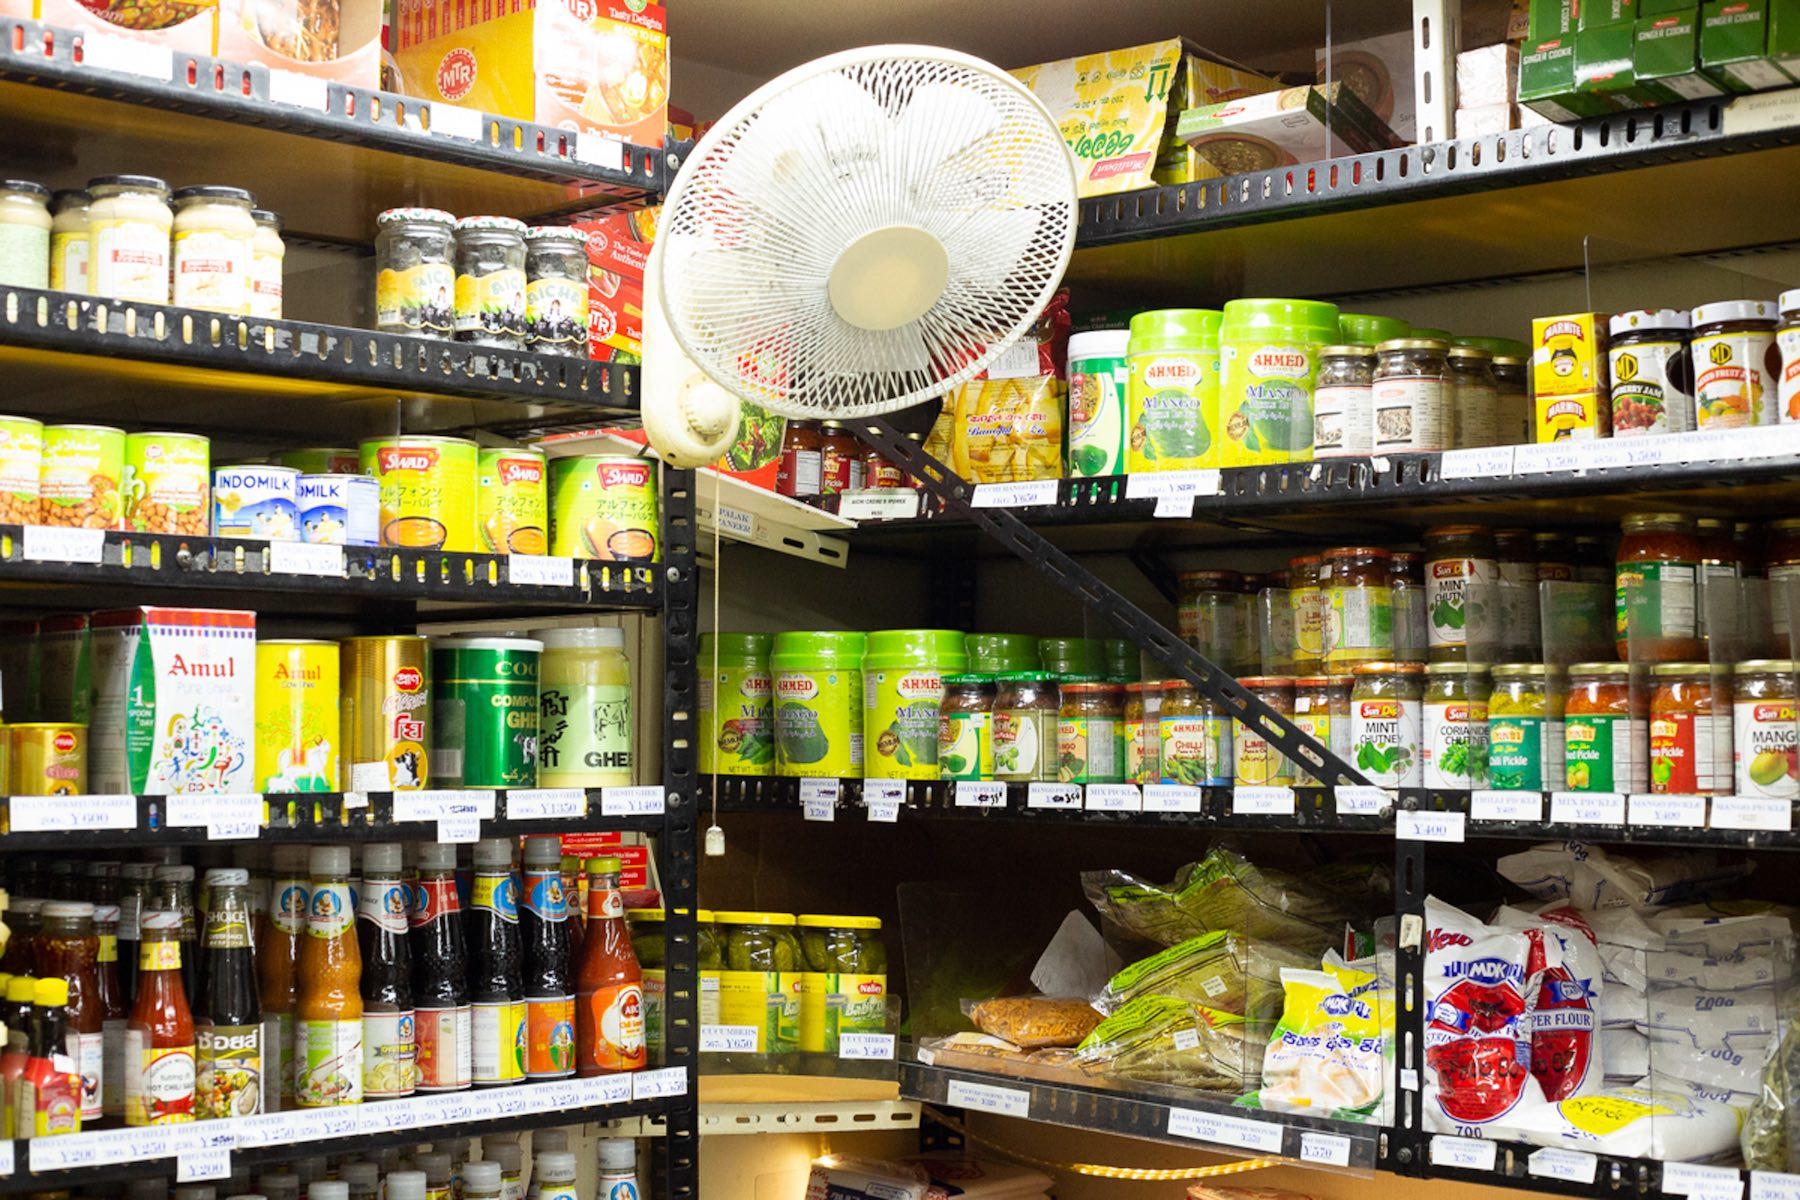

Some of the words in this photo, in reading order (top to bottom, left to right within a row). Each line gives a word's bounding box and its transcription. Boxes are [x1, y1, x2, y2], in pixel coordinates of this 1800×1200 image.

[443, 61, 471, 89] MTR
[610, 251, 646, 270] Authent
[1545, 321, 1582, 338] MARMITE
[1254, 353, 1304, 368] AHMED
[1711, 345, 1731, 362] MD
[1148, 365, 1197, 379] AHMED
[1616, 357, 1638, 379] MD
[1548, 400, 1584, 417] MARMITE
[385, 454, 429, 471] SWAD
[219, 474, 290, 491] INDOMILK
[606, 469, 644, 486] SWAD
[1436, 565, 1451, 577] Sun
[168, 653, 235, 678] Amul
[273, 662, 321, 680] Amul
[1363, 703, 1379, 714] Sun
[1449, 708, 1468, 719] Sun
[1757, 707, 1778, 719] Sun
[1366, 722, 1398, 734] MINT
[1440, 726, 1489, 736] CORIANDE
[1576, 751, 1600, 760] Pickle
[1661, 747, 1684, 757] Pickle
[1503, 755, 1528, 766] Pickle
[1425, 927, 1473, 953] New
[1469, 963, 1507, 979] MDK
[859, 985, 881, 994] Nalley
[1555, 1011, 1591, 1026] FLOUR
[1455, 1126, 1482, 1138] 700
